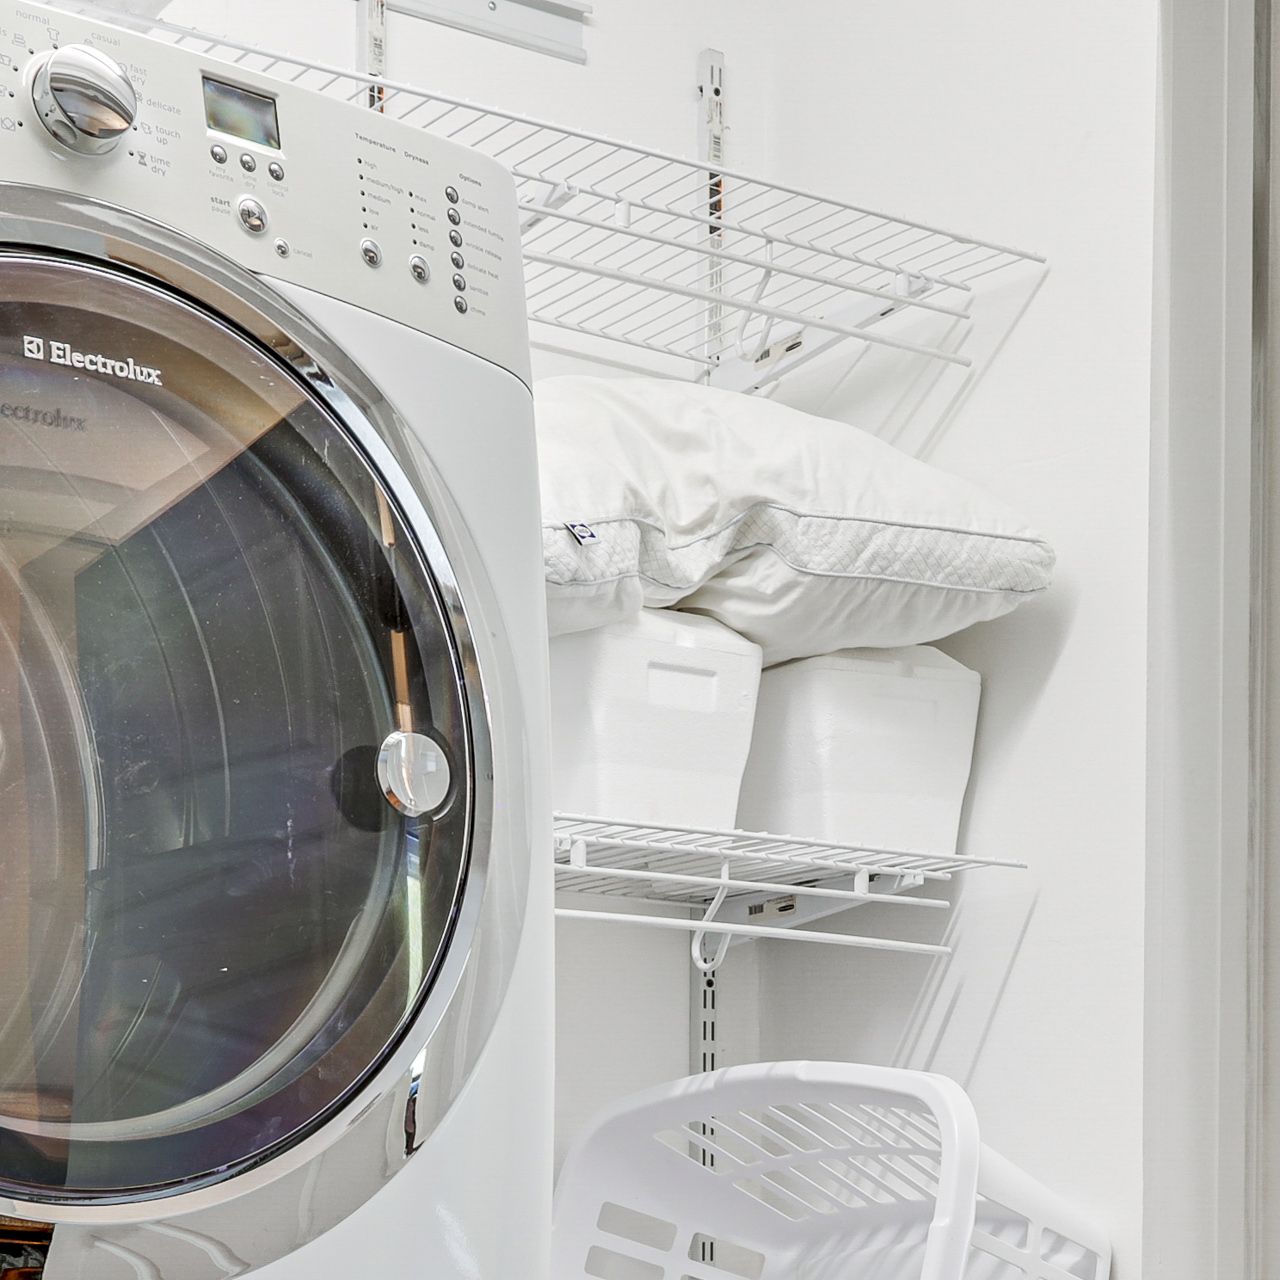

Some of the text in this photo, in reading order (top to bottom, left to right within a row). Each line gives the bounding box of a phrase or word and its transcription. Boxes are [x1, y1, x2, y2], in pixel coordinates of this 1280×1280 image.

[16, 9, 49, 25] normal
[91, 31, 120, 46] casual
[129, 64, 147, 76] fast
[130, 72, 146, 86] dry
[146, 98, 182, 115] delicate
[155, 125, 181, 139] touch
[157, 133, 168, 145] up
[355, 133, 396, 152] Temperature
[150, 154, 171, 167] time
[404, 152, 429, 165] Dryness
[152, 165, 166, 176] dry
[459, 173, 482, 187] Options
[210, 196, 231, 207] start
[49, 341, 162, 386] Electrolux
